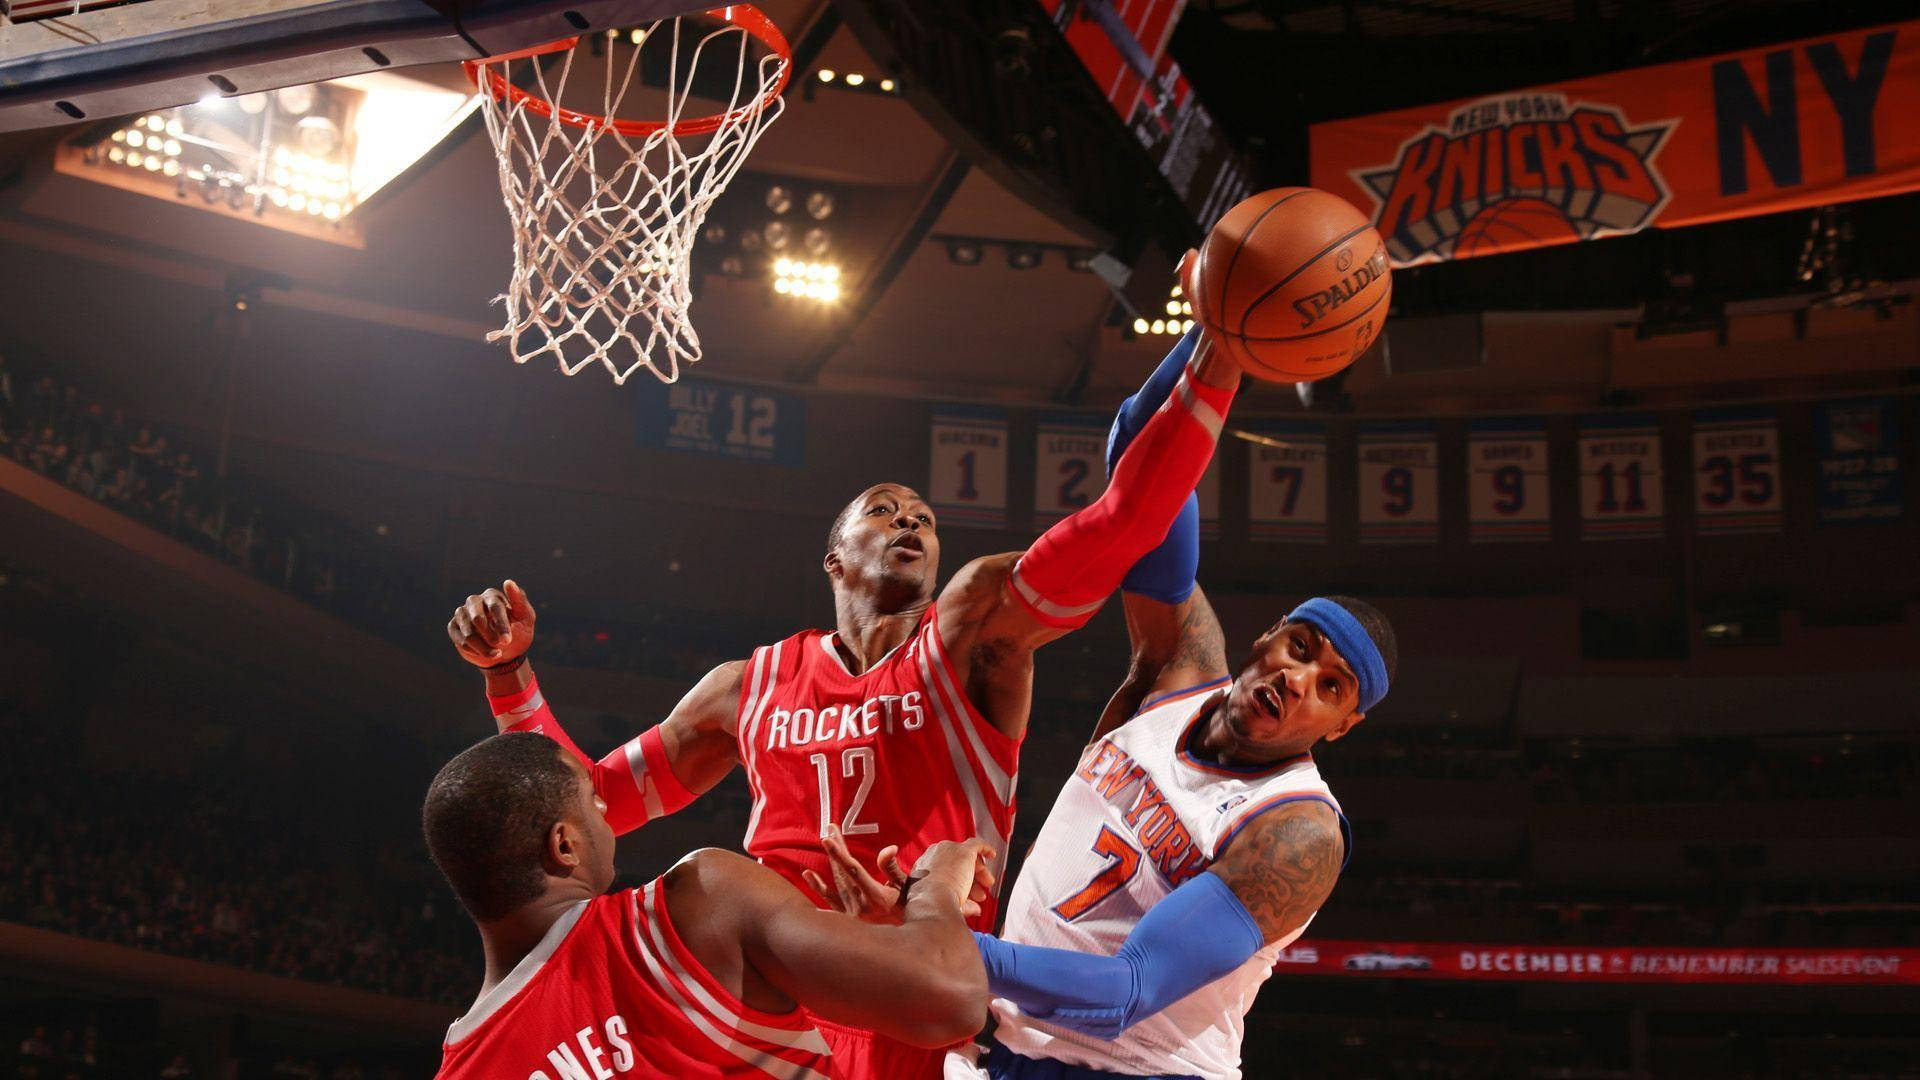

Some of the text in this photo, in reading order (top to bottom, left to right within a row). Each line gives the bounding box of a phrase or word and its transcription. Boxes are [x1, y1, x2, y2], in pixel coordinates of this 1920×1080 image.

[1451, 95, 1565, 131] NEW YORK
[1711, 31, 1898, 196] NY
[1376, 108, 1664, 242] KNICKS
[669, 411, 712, 440] JOEL
[726, 393, 777, 447] 12
[957, 449, 978, 501] 1
[1058, 458, 1090, 510] 2
[1271, 466, 1303, 517] 7
[1382, 467, 1414, 518] 9
[1492, 465, 1525, 515] 9
[1597, 461, 1648, 513] 11
[1701, 453, 1772, 509] 35
[766, 690, 925, 751] ROCKETS
[810, 746, 880, 840] 12
[1125, 776, 1213, 888] YORK
[1050, 823, 1143, 923] 7
[1459, 951, 1603, 973] DECEMBER
[1630, 954, 1780, 975] REMEMBER
[527, 1015, 635, 1080] NES
